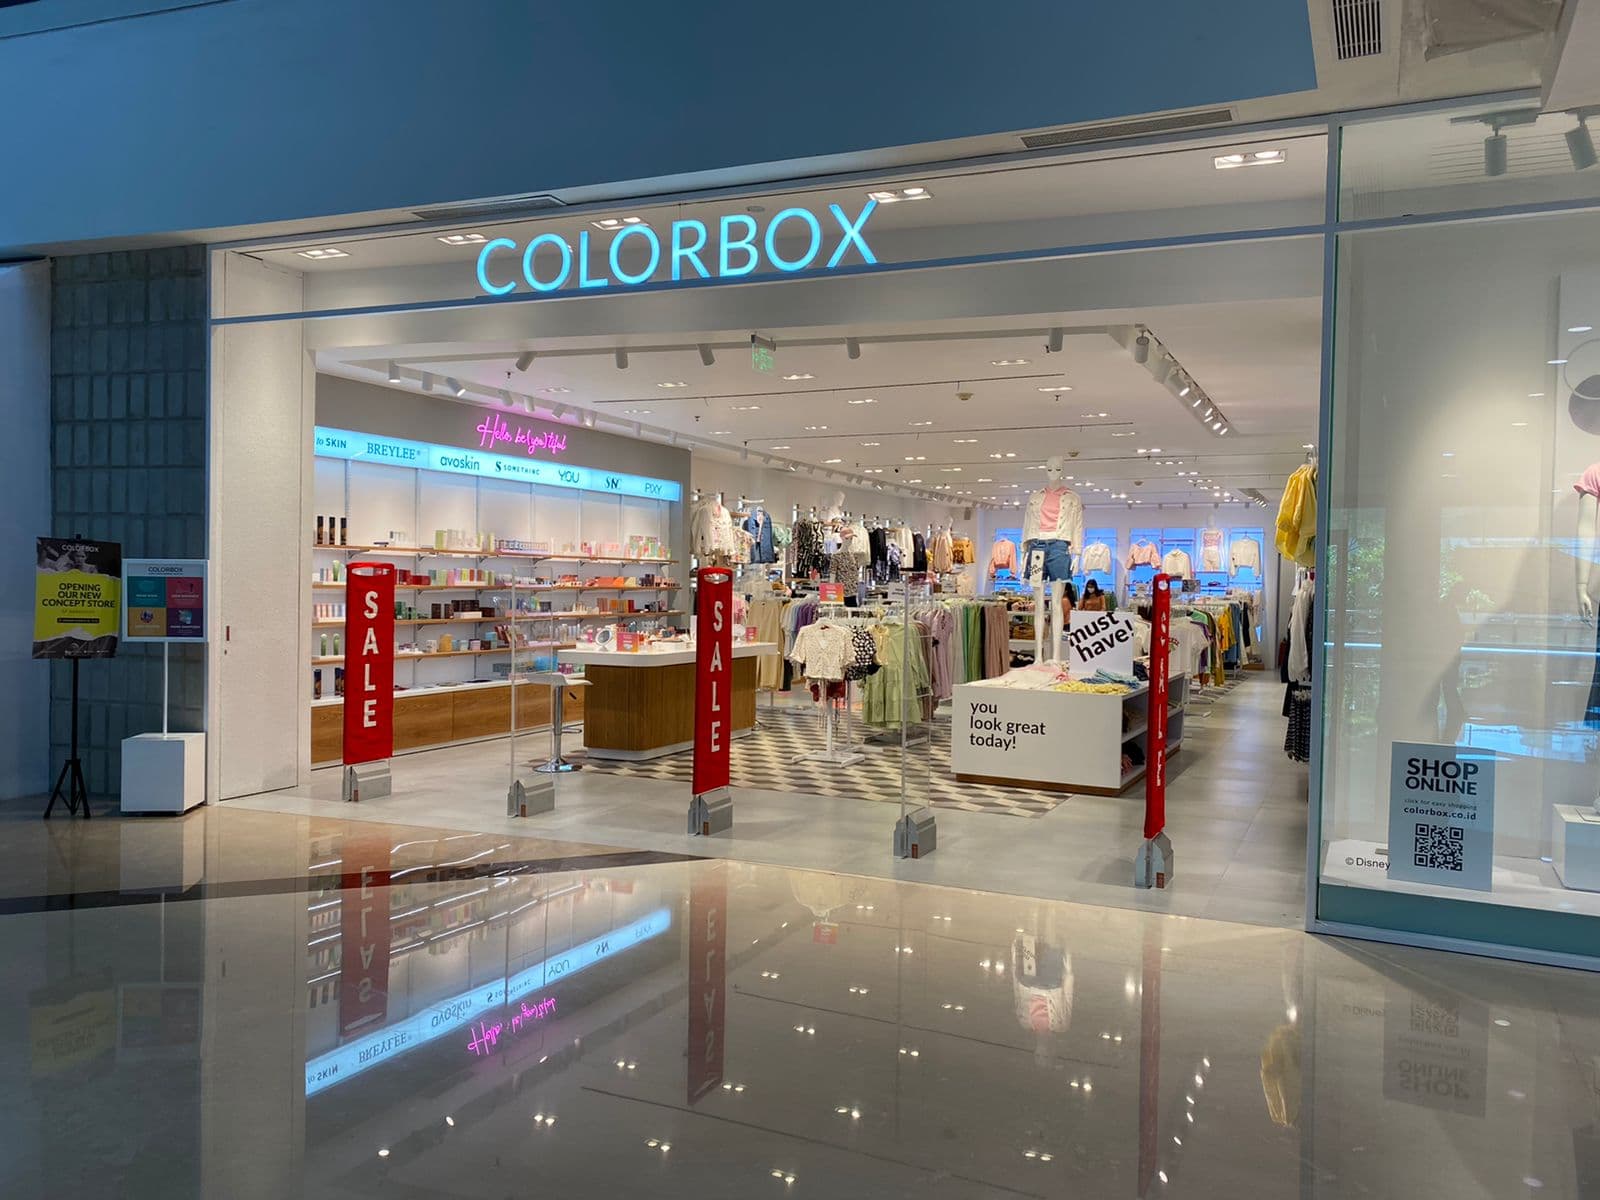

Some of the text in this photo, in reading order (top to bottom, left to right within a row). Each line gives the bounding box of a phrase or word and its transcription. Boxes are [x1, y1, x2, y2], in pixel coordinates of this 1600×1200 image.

[476, 200, 878, 295] COLORBOX
[326, 438, 347, 449] SKIN
[440, 454, 480, 470] avoskin
[558, 470, 580, 484] YOU
[57, 591, 78, 599] OUR
[59, 582, 101, 592] OPENING
[42, 598, 115, 608] CONCEPT STORE
[1069, 612, 1120, 647] must
[1075, 619, 1134, 662] have!
[362, 590, 379, 728] SALE
[710, 601, 723, 753] SALE
[970, 702, 997, 715] you
[970, 715, 1046, 735] look great
[969, 733, 1016, 751] today!
[1407, 758, 1479, 780] SHOP
[1405, 776, 1477, 795] ONLINE
[1403, 806, 1476, 820] colorbox.co.id
[1356, 857, 1391, 870] Disney
